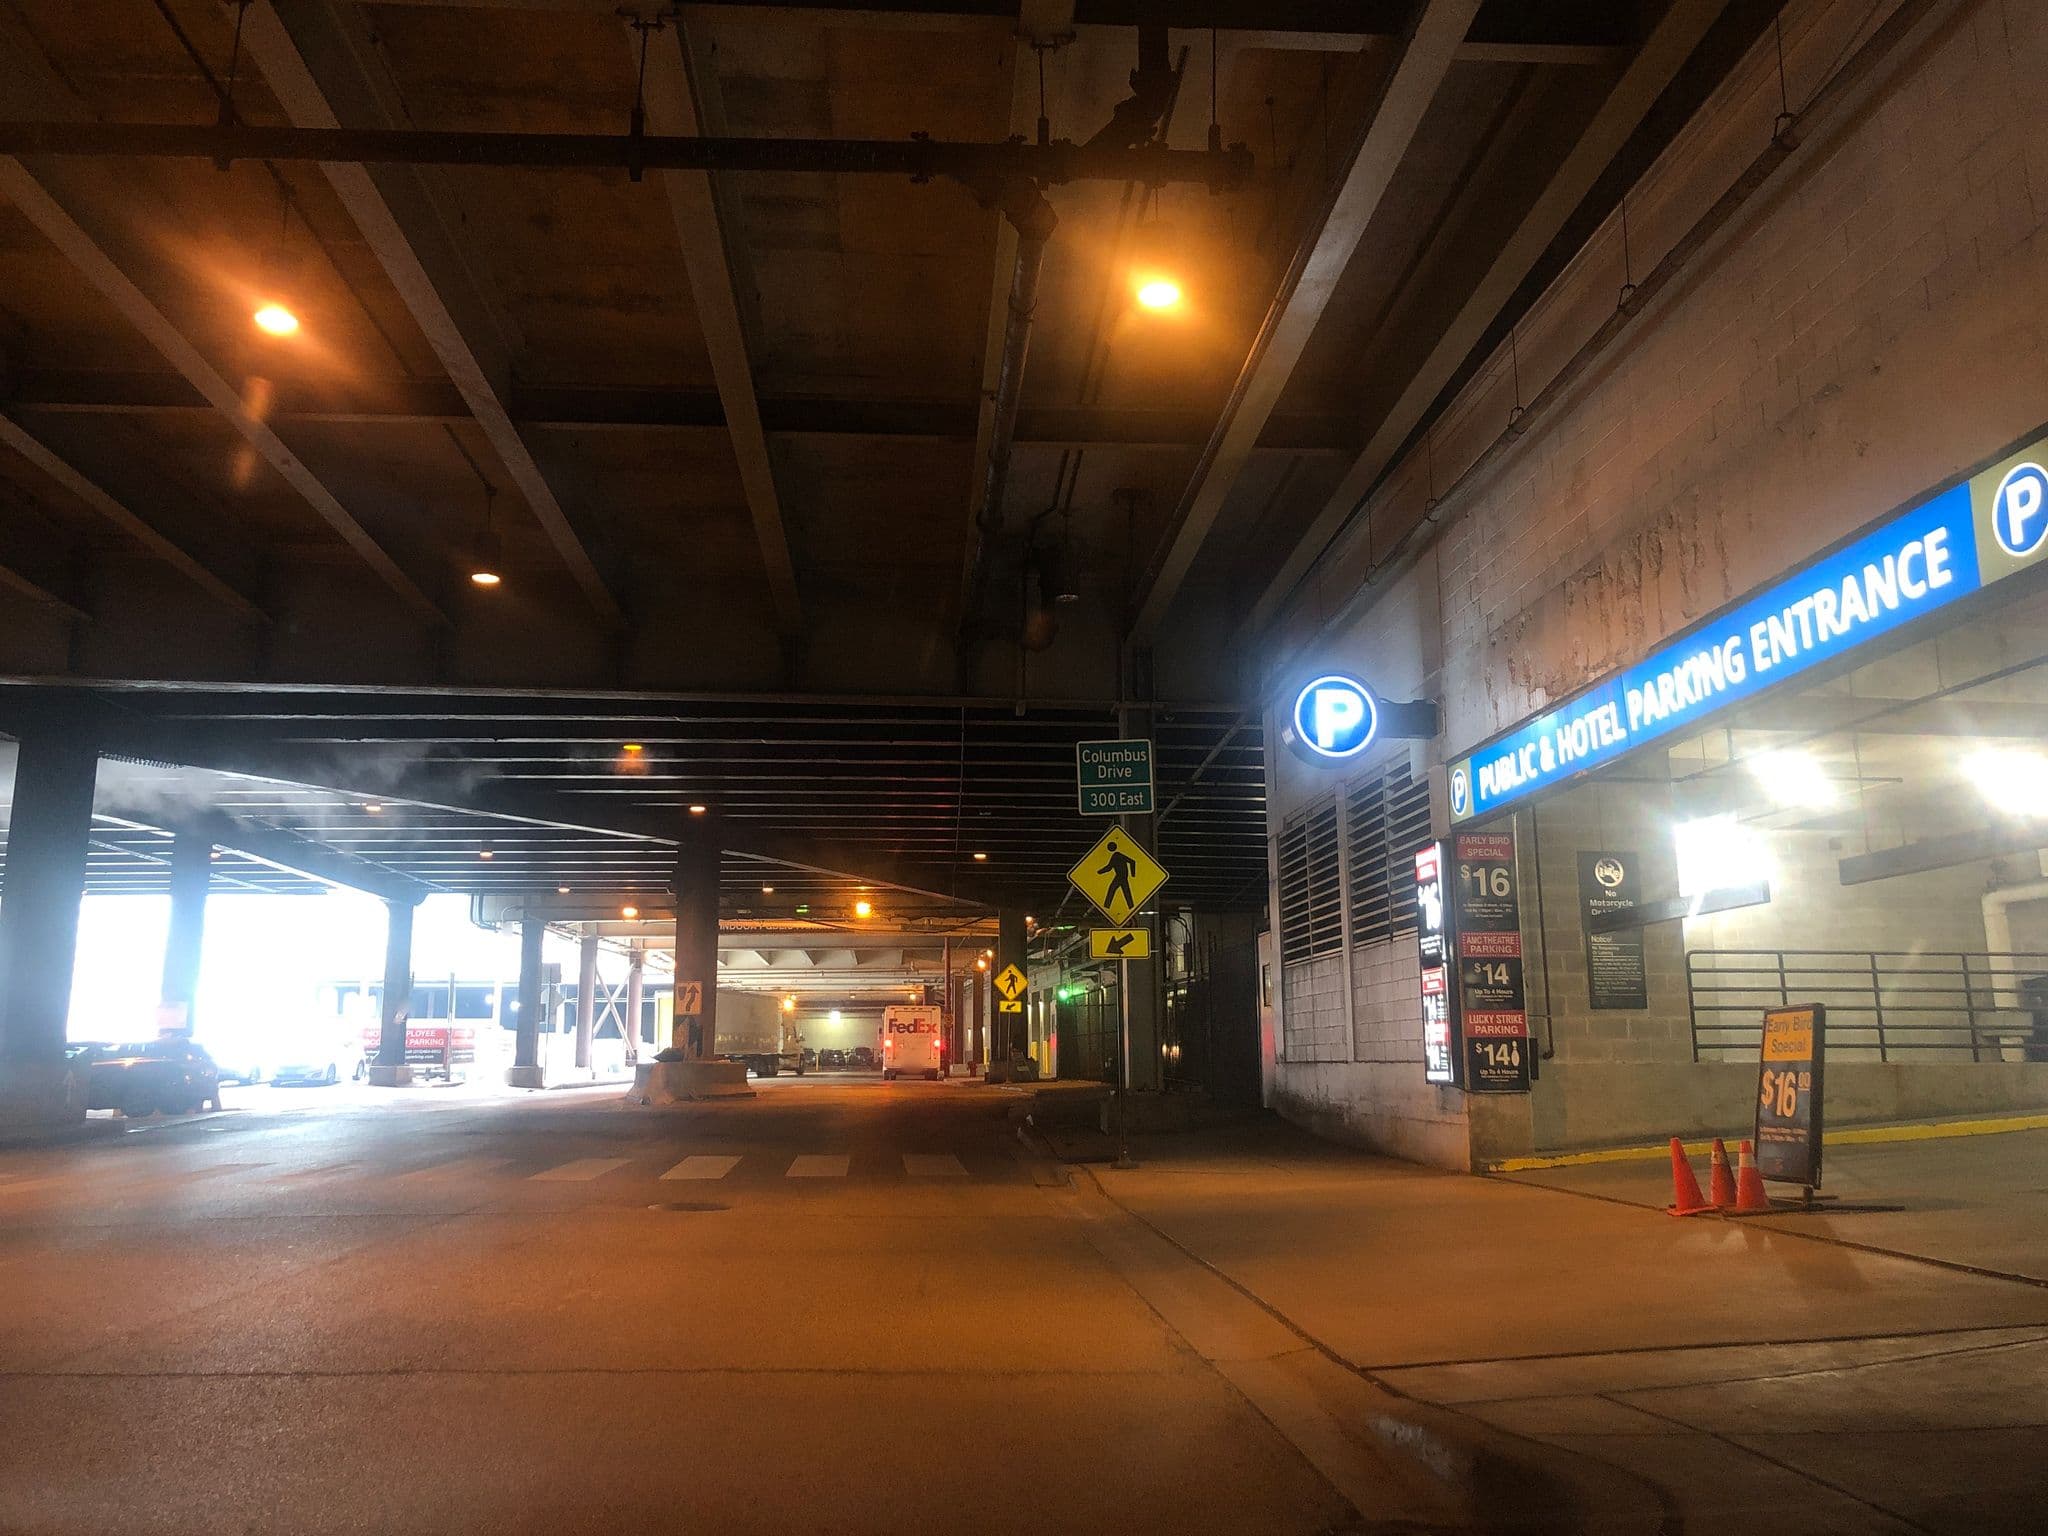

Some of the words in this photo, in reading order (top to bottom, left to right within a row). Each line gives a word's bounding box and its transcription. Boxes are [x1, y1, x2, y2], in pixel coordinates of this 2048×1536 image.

[2005, 475, 2042, 545] P
[1479, 742, 1538, 800] PUBLIC
[1539, 735, 1556, 772] &
[1557, 701, 1627, 765] HOTEL
[1627, 635, 1746, 731] PARKING
[1750, 526, 1952, 672] ENTRANCE
[1315, 689, 1364, 748] P
[1082, 749, 1147, 763] Columbus
[1098, 765, 1132, 779] Drive
[1090, 792, 1116, 806] 300
[1120, 791, 1144, 806] East
[1460, 836, 1487, 845] EARLY
[1489, 836, 1510, 845] BIRD
[1467, 848, 1504, 857] SPECIAL
[1461, 865, 1511, 897] $16
[1589, 899, 1634, 908] Motorcycle
[1466, 936, 1482, 945] AMC
[1483, 935, 1515, 945] THEATRE
[1470, 945, 1512, 954] PARKING
[1474, 962, 1510, 985] $14
[888, 1018, 937, 1034] FedEx
[1468, 1014, 1494, 1024] LUCKY
[1495, 1014, 1523, 1024] STRIKE
[1475, 1025, 1519, 1034] PARKING
[1768, 1018, 1790, 1036] Early
[1475, 1042, 1511, 1066] $14
[1761, 1068, 1796, 1117] $16
